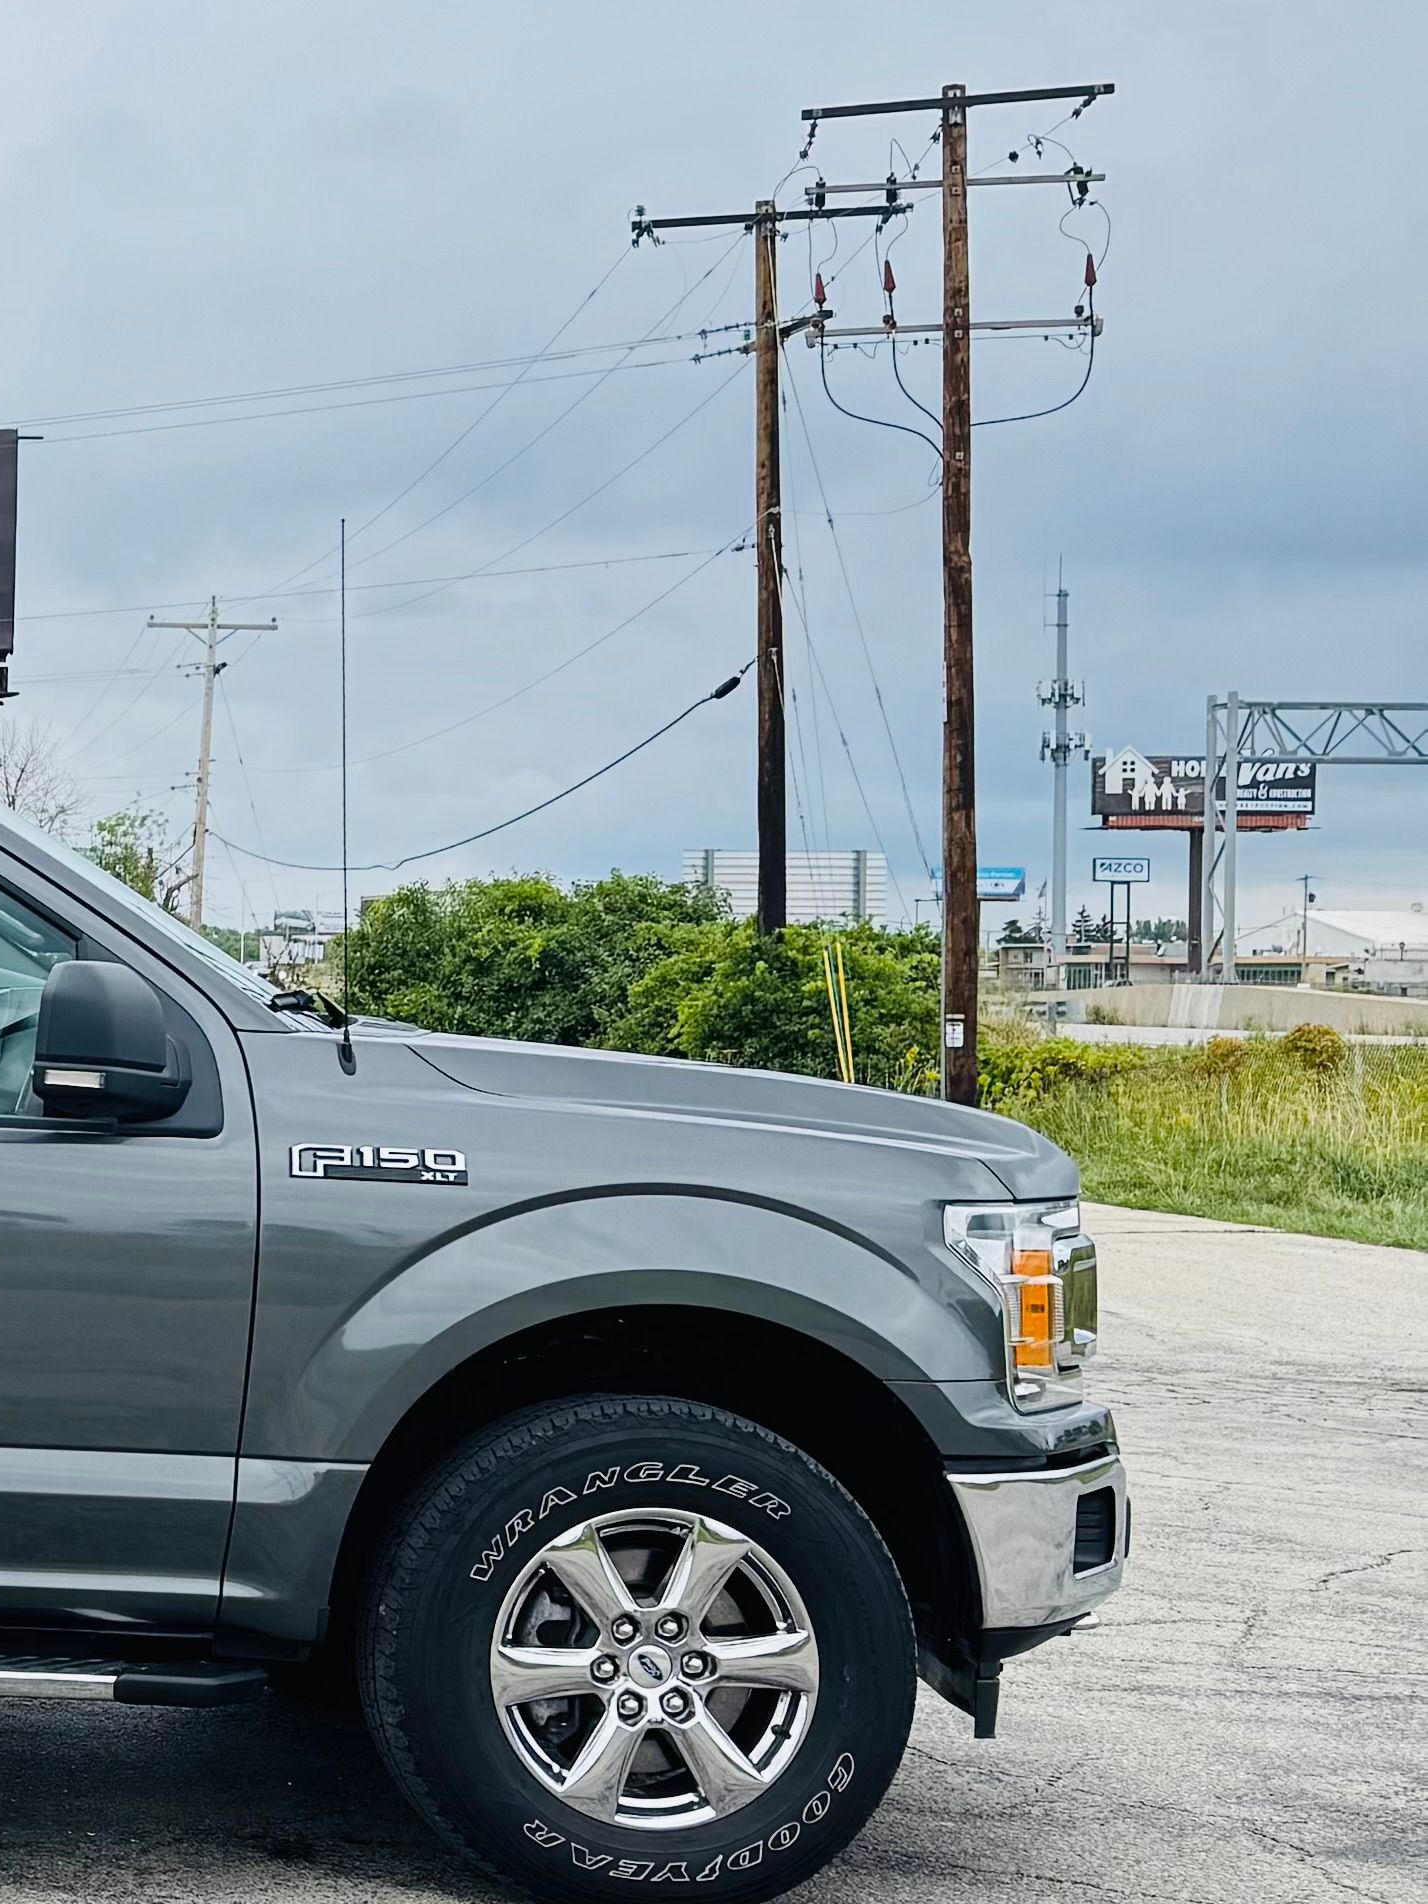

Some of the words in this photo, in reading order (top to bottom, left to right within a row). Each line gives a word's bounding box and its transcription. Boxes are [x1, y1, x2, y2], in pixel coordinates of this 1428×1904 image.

[1099, 862, 1144, 874] AZCO
[420, 1171, 459, 1182] XLT
[469, 1461, 793, 1582] WRANGLER
[523, 1752, 855, 1883] GOODYEAR
